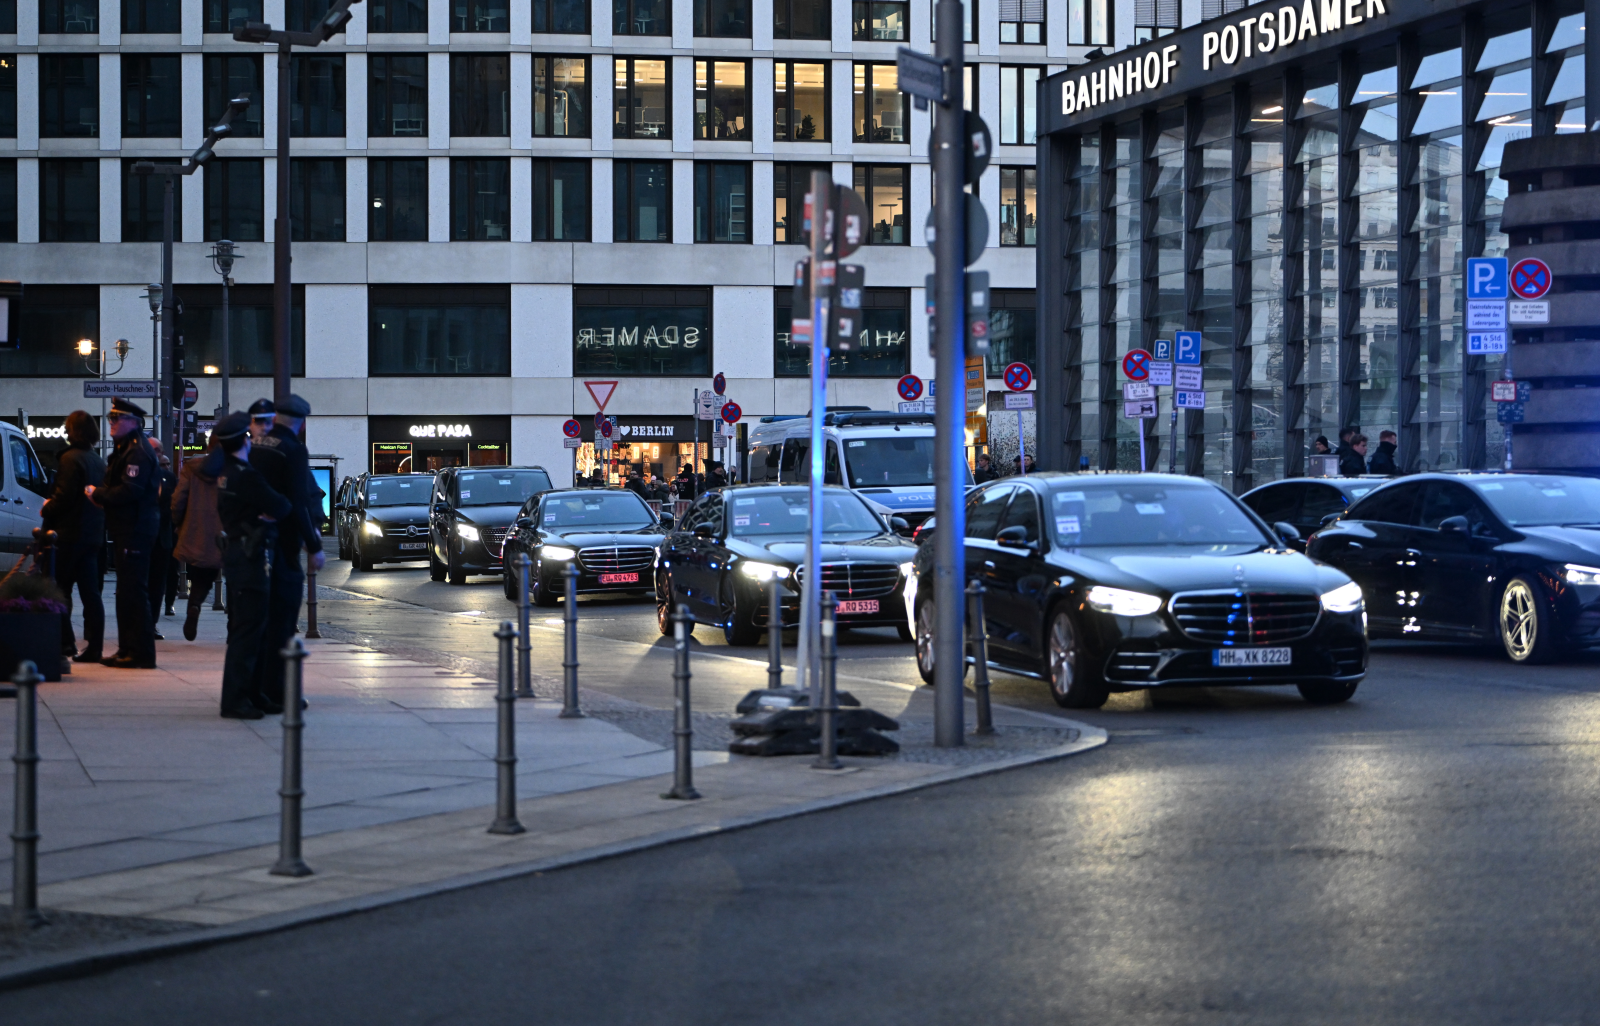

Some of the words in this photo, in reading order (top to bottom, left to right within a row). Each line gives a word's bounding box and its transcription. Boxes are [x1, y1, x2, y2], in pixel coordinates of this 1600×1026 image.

[1062, 45, 1177, 115] BAHNHOF
[1474, 263, 1496, 294] P
[1157, 342, 1167, 358] P
[1179, 335, 1193, 360] P
[86, 384, 156, 394] Auguste-Hauschner-Str.
[36, 425, 69, 438] root
[409, 425, 436, 437] QUE
[437, 424, 472, 437] PASA
[631, 425, 675, 436] BERLIN
[845, 602, 857, 611] RQ
[858, 601, 878, 611] 5315
[1220, 650, 1235, 664] HH
[1244, 649, 1259, 664] XK
[1261, 649, 1289, 663] 8228
